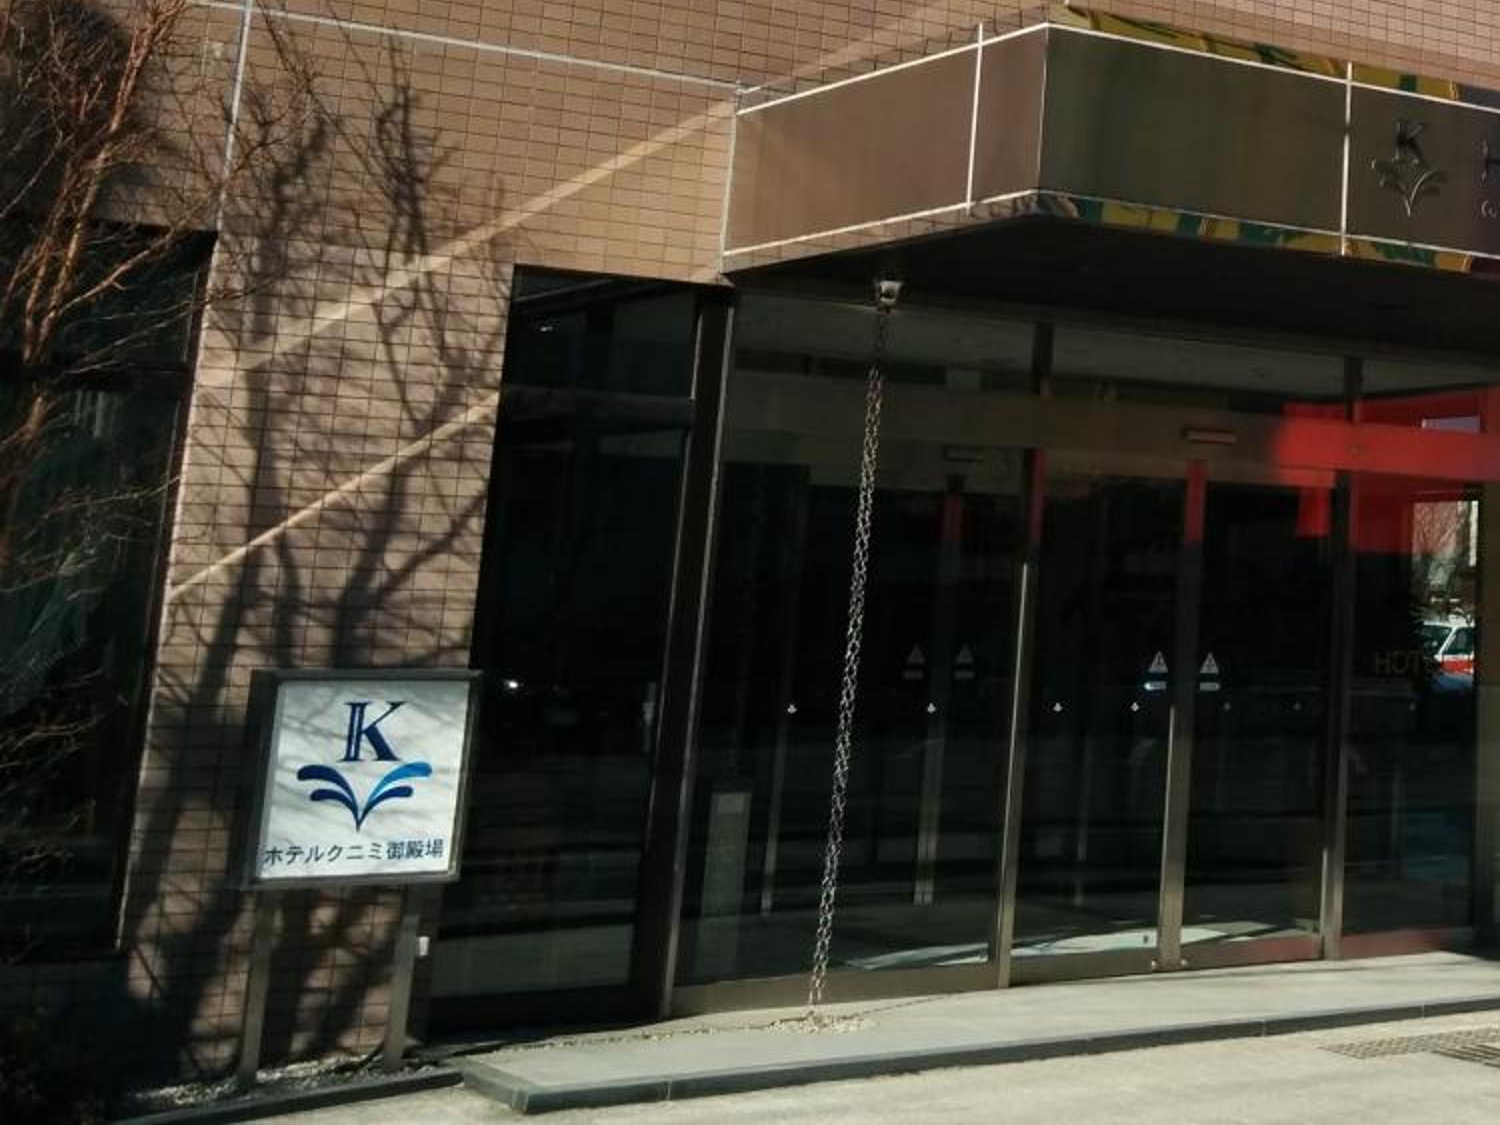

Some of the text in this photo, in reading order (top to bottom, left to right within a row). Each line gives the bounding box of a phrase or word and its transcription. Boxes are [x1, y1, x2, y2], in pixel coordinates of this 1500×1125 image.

[340, 701, 405, 762] K
[264, 839, 444, 866] ホテルクニミ御殿場
